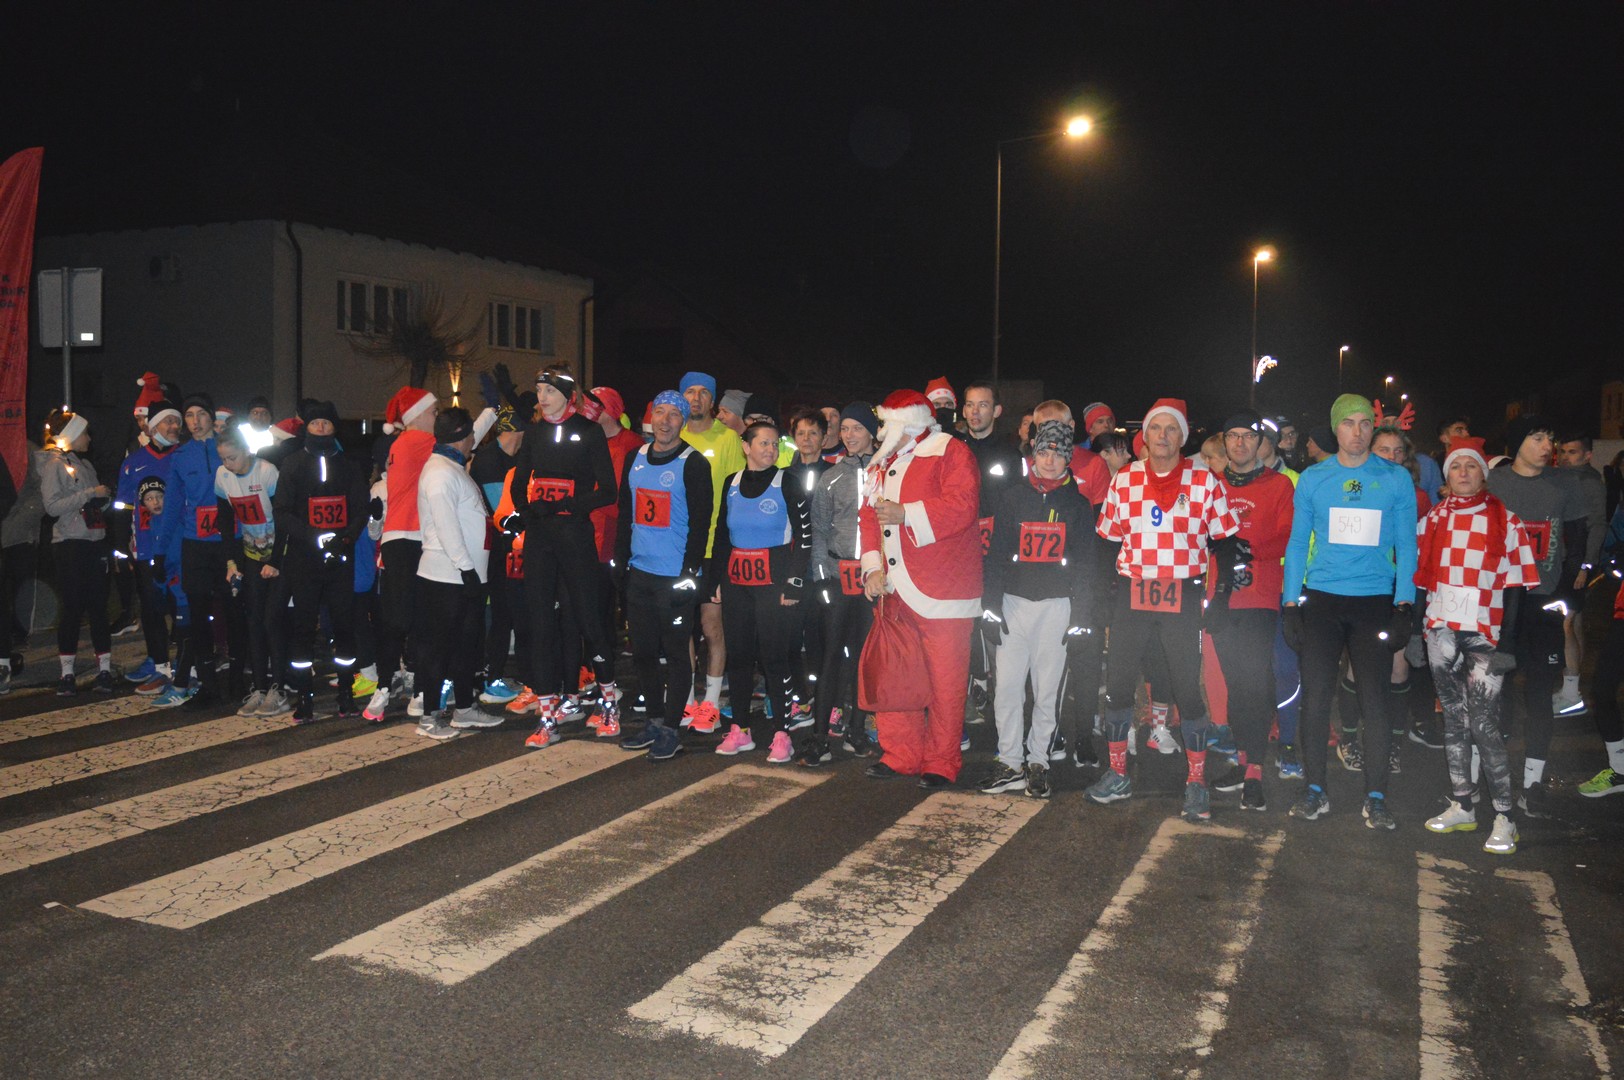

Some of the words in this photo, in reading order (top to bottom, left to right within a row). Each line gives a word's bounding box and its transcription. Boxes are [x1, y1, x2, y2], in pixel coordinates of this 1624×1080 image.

[312, 504, 343, 525] 532
[643, 499, 655, 522] 3
[1151, 505, 1163, 527] 9
[1338, 515, 1362, 534] 549
[1022, 532, 1061, 558] 372
[731, 558, 766, 581] 408
[1136, 580, 1178, 607] 164
